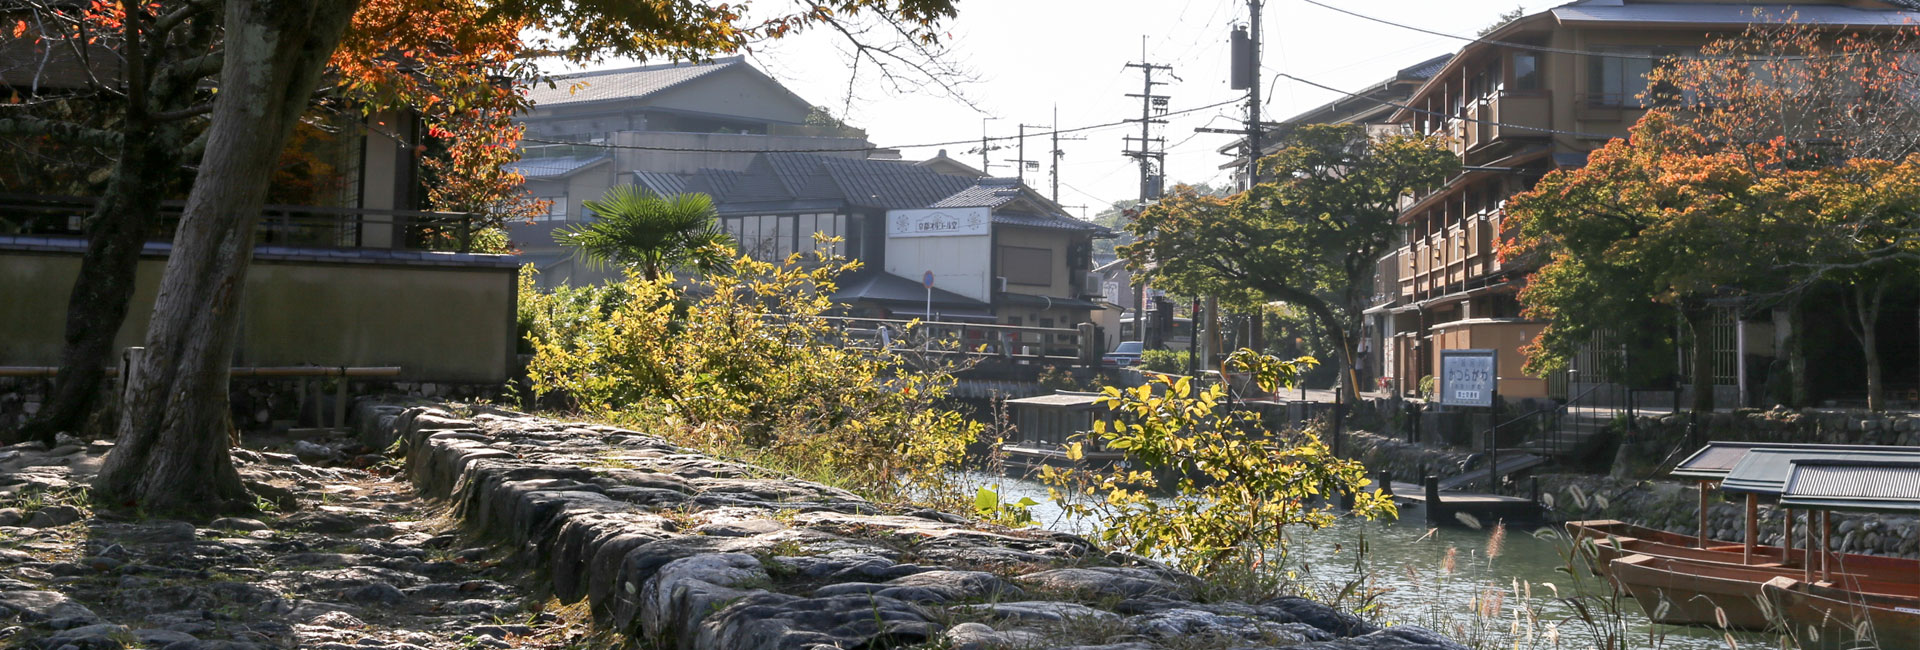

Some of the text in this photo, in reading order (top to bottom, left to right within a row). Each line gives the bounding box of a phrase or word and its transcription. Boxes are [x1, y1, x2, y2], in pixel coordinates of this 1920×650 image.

[1448, 368, 1489, 382] かつらがわ
